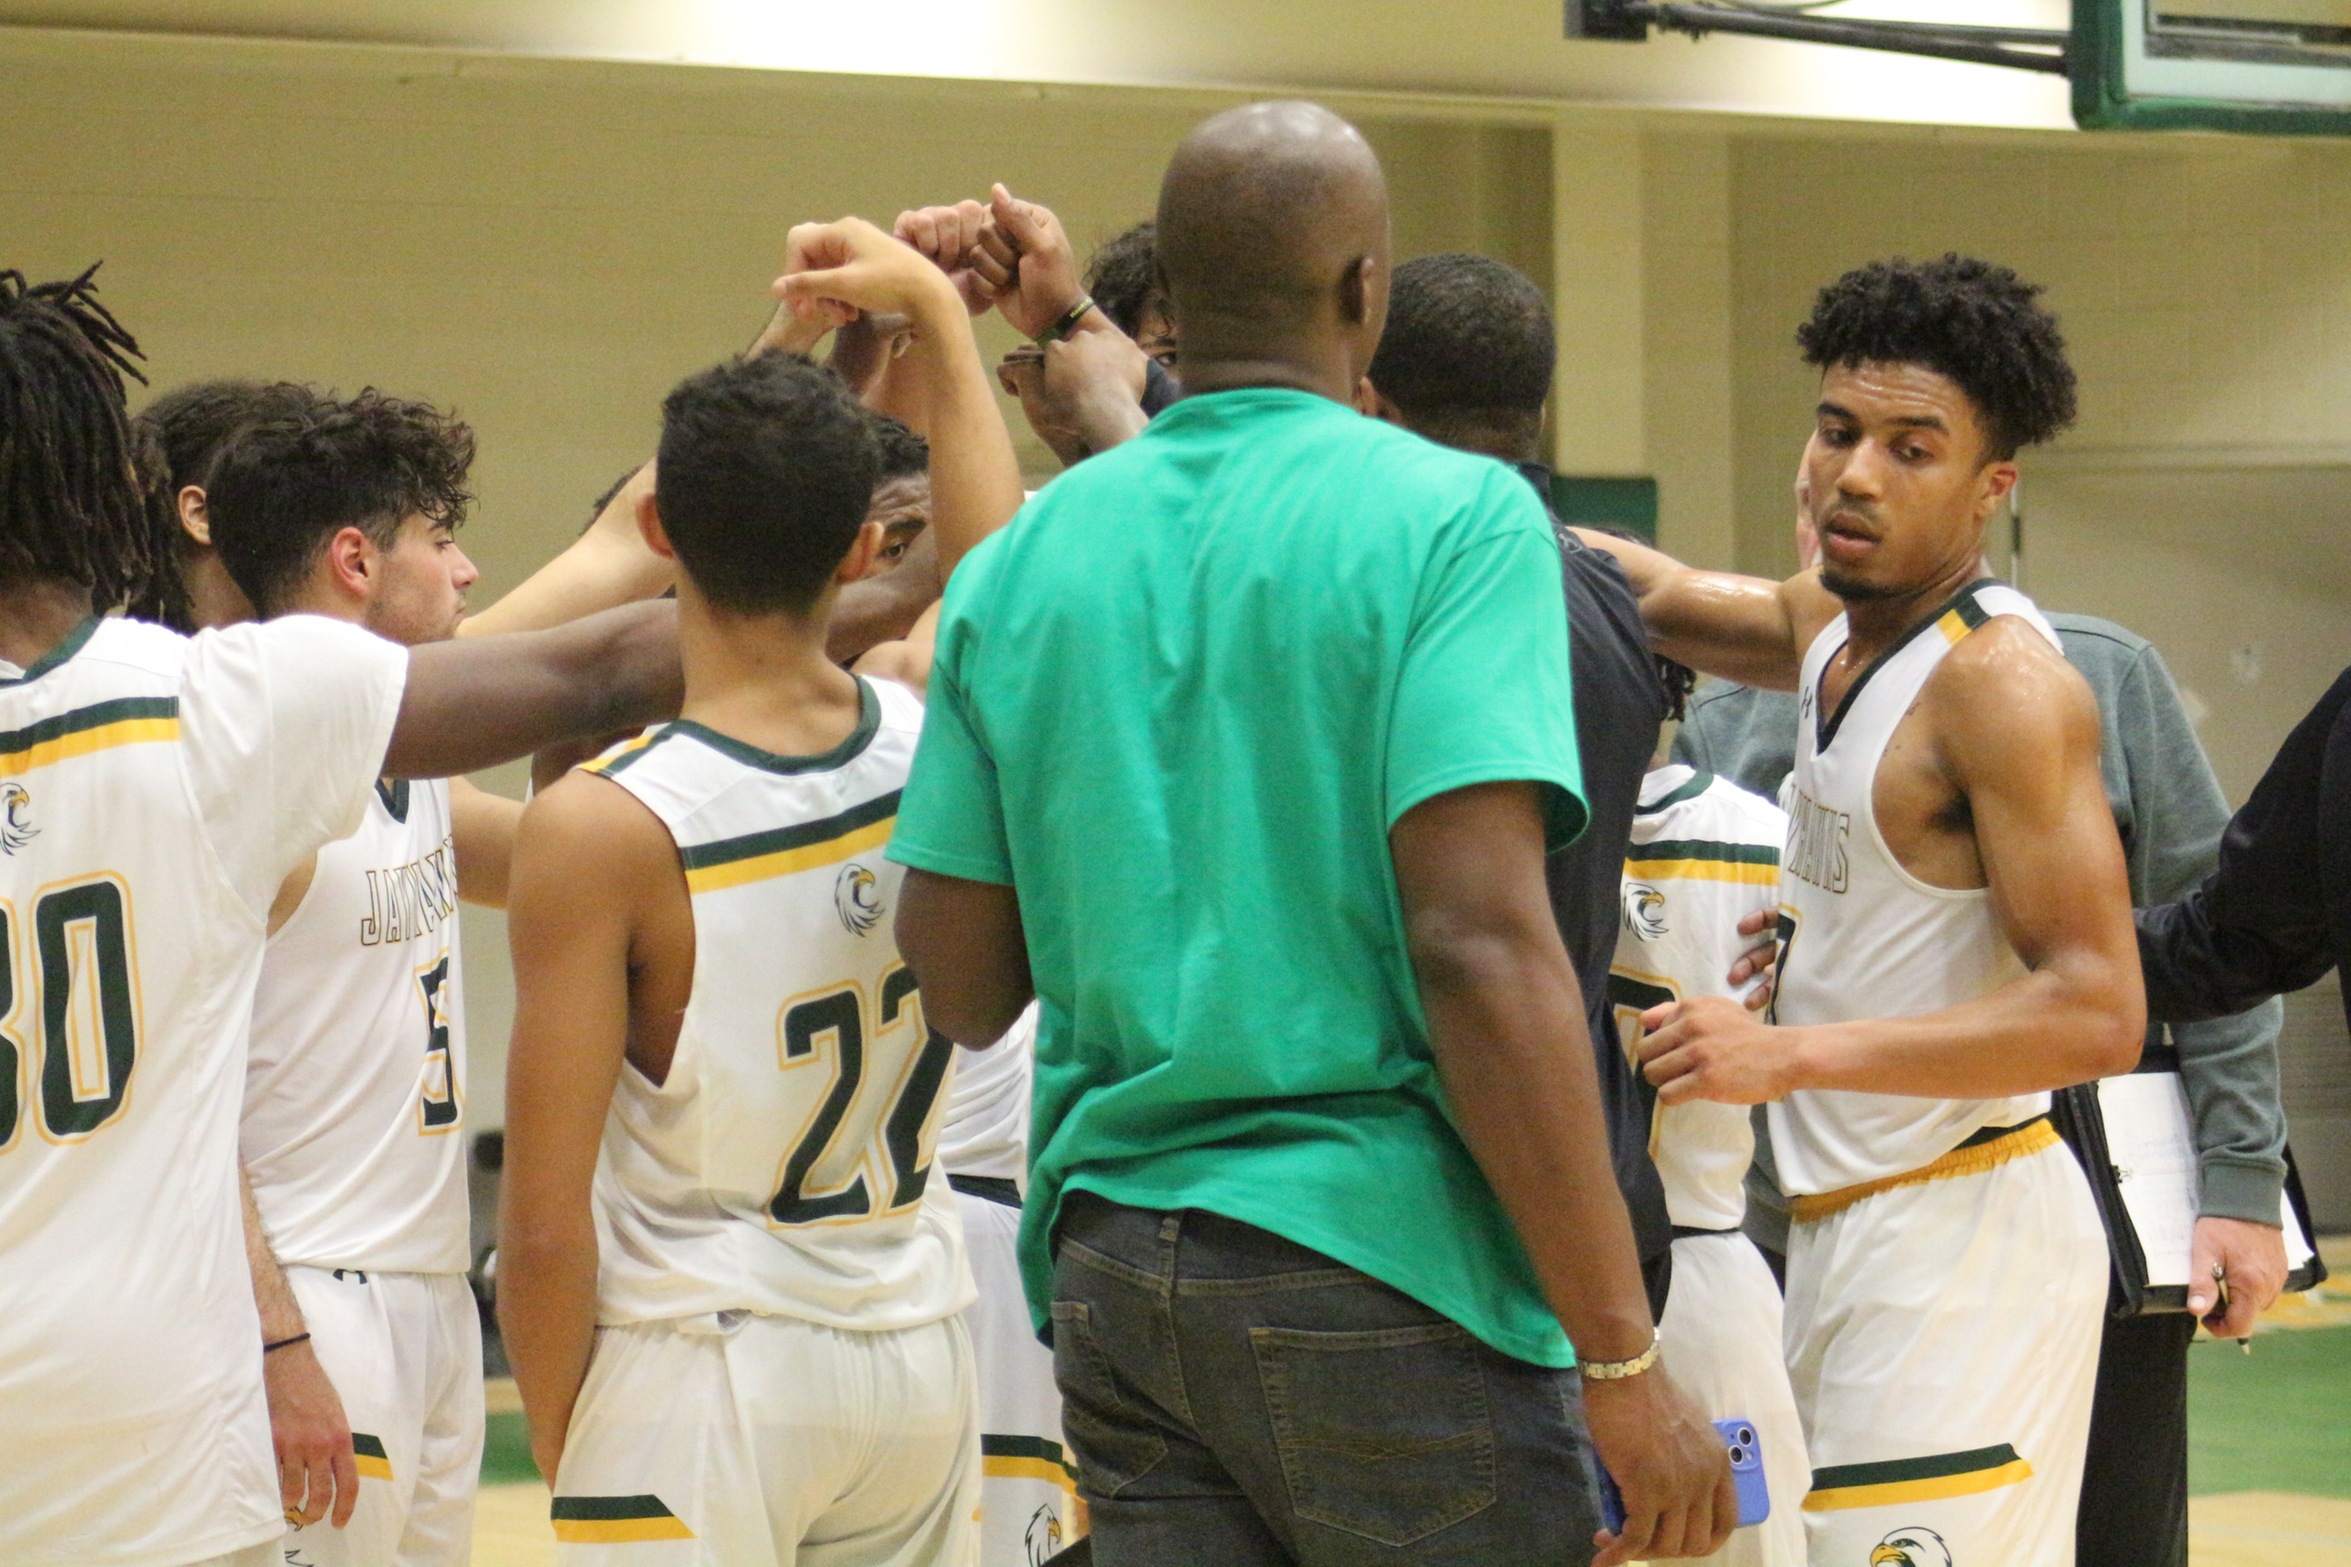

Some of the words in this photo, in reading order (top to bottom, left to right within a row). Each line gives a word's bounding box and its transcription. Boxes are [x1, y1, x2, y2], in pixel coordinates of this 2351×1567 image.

[0, 868, 145, 1157] 0
[413, 946, 467, 1137] 5
[766, 957, 956, 1231] 22
